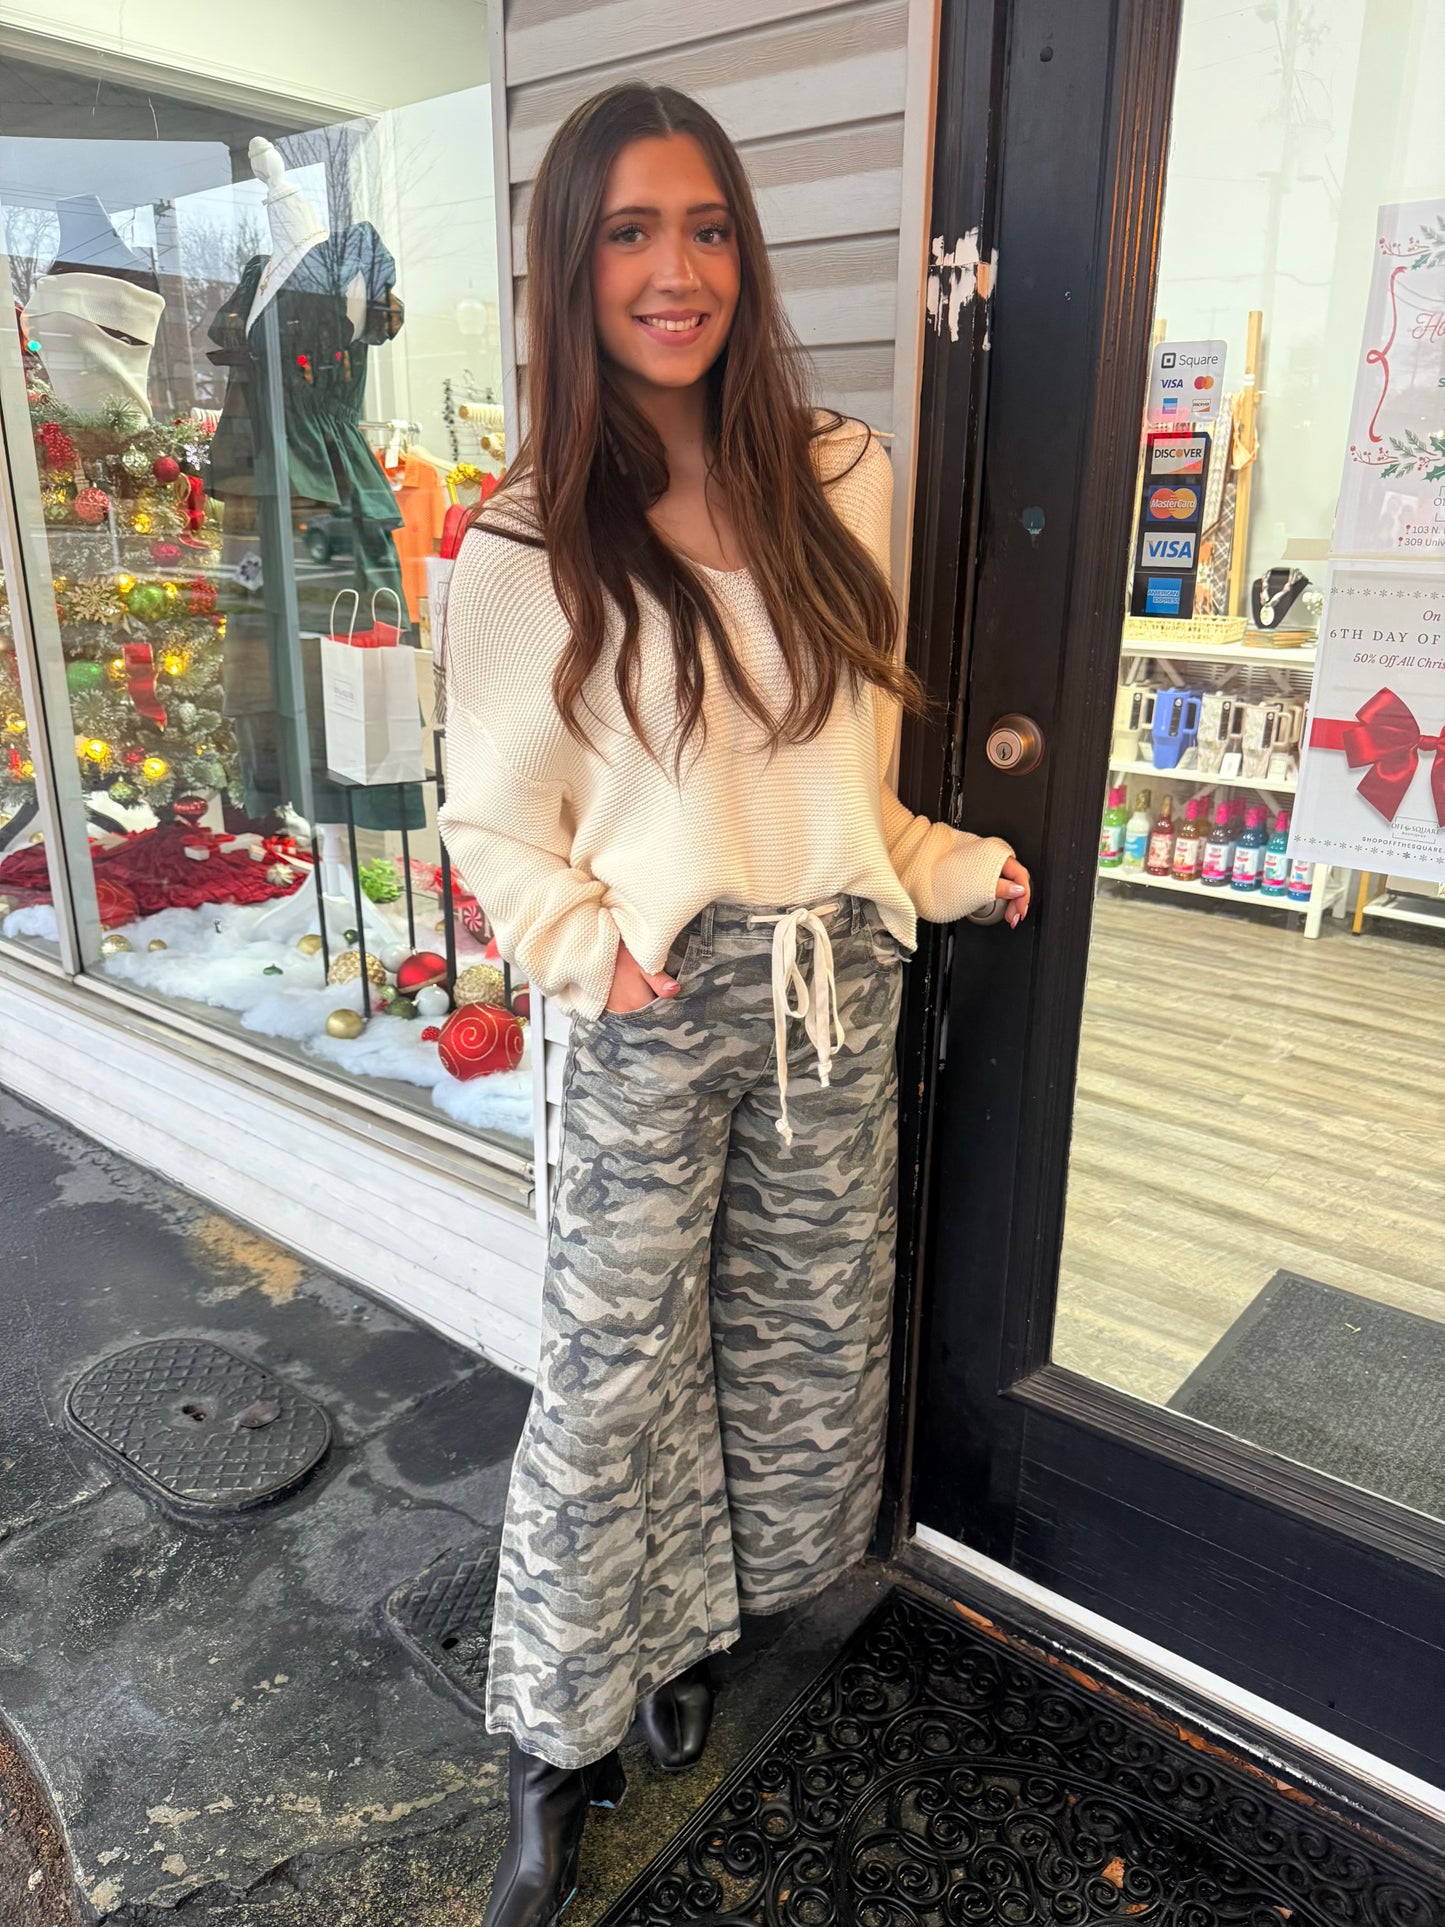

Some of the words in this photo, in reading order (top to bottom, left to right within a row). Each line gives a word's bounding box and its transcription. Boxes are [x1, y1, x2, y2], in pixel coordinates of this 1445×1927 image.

[1179, 354, 1219, 368] Square
[1161, 379, 1184, 389] VISA
[1154, 448, 1203, 458] DISCOVER
[1151, 498, 1195, 509] MasterCard
[1412, 525, 1429, 534] 103
[1431, 526, 1441, 535] N.
[1404, 537, 1423, 546] 309
[1148, 540, 1192, 559] VISA
[1148, 589, 1180, 597] AMERICAN
[1423, 609, 1441, 622] On
[1329, 628, 1363, 640] 6TH
[1372, 630, 1409, 643] DAY
[1417, 633, 1441, 645] OF
[1353, 652, 1377, 664] 50%
[1379, 654, 1400, 668] Off
[1397, 656, 1415, 667] All
[1411, 826, 1440, 835] SQUARE
